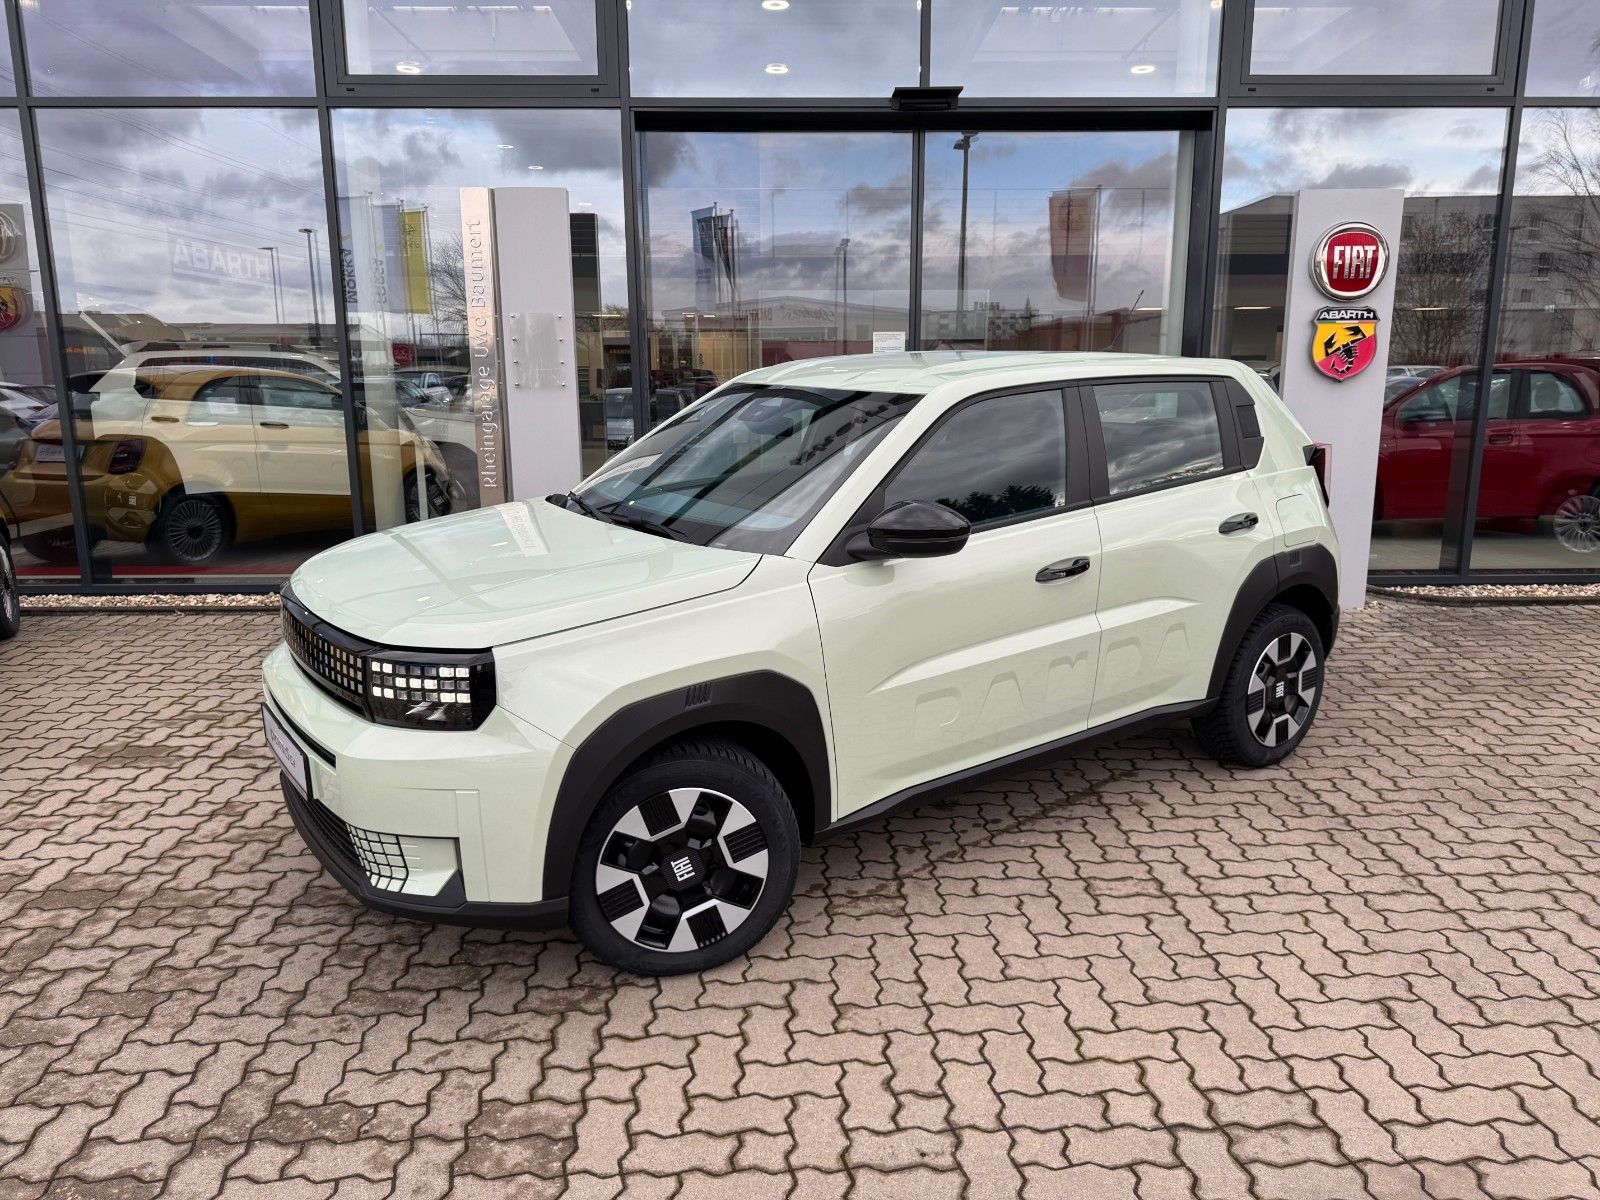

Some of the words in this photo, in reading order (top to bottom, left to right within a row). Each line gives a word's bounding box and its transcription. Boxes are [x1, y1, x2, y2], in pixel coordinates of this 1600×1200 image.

[466, 218, 486, 308] Baumert
[1332, 245, 1377, 279] FIAT
[1319, 309, 1374, 319] ABARTH
[473, 316, 489, 358] Uwe
[480, 365, 498, 487] Rheingarage
[670, 856, 696, 882] FIAT
